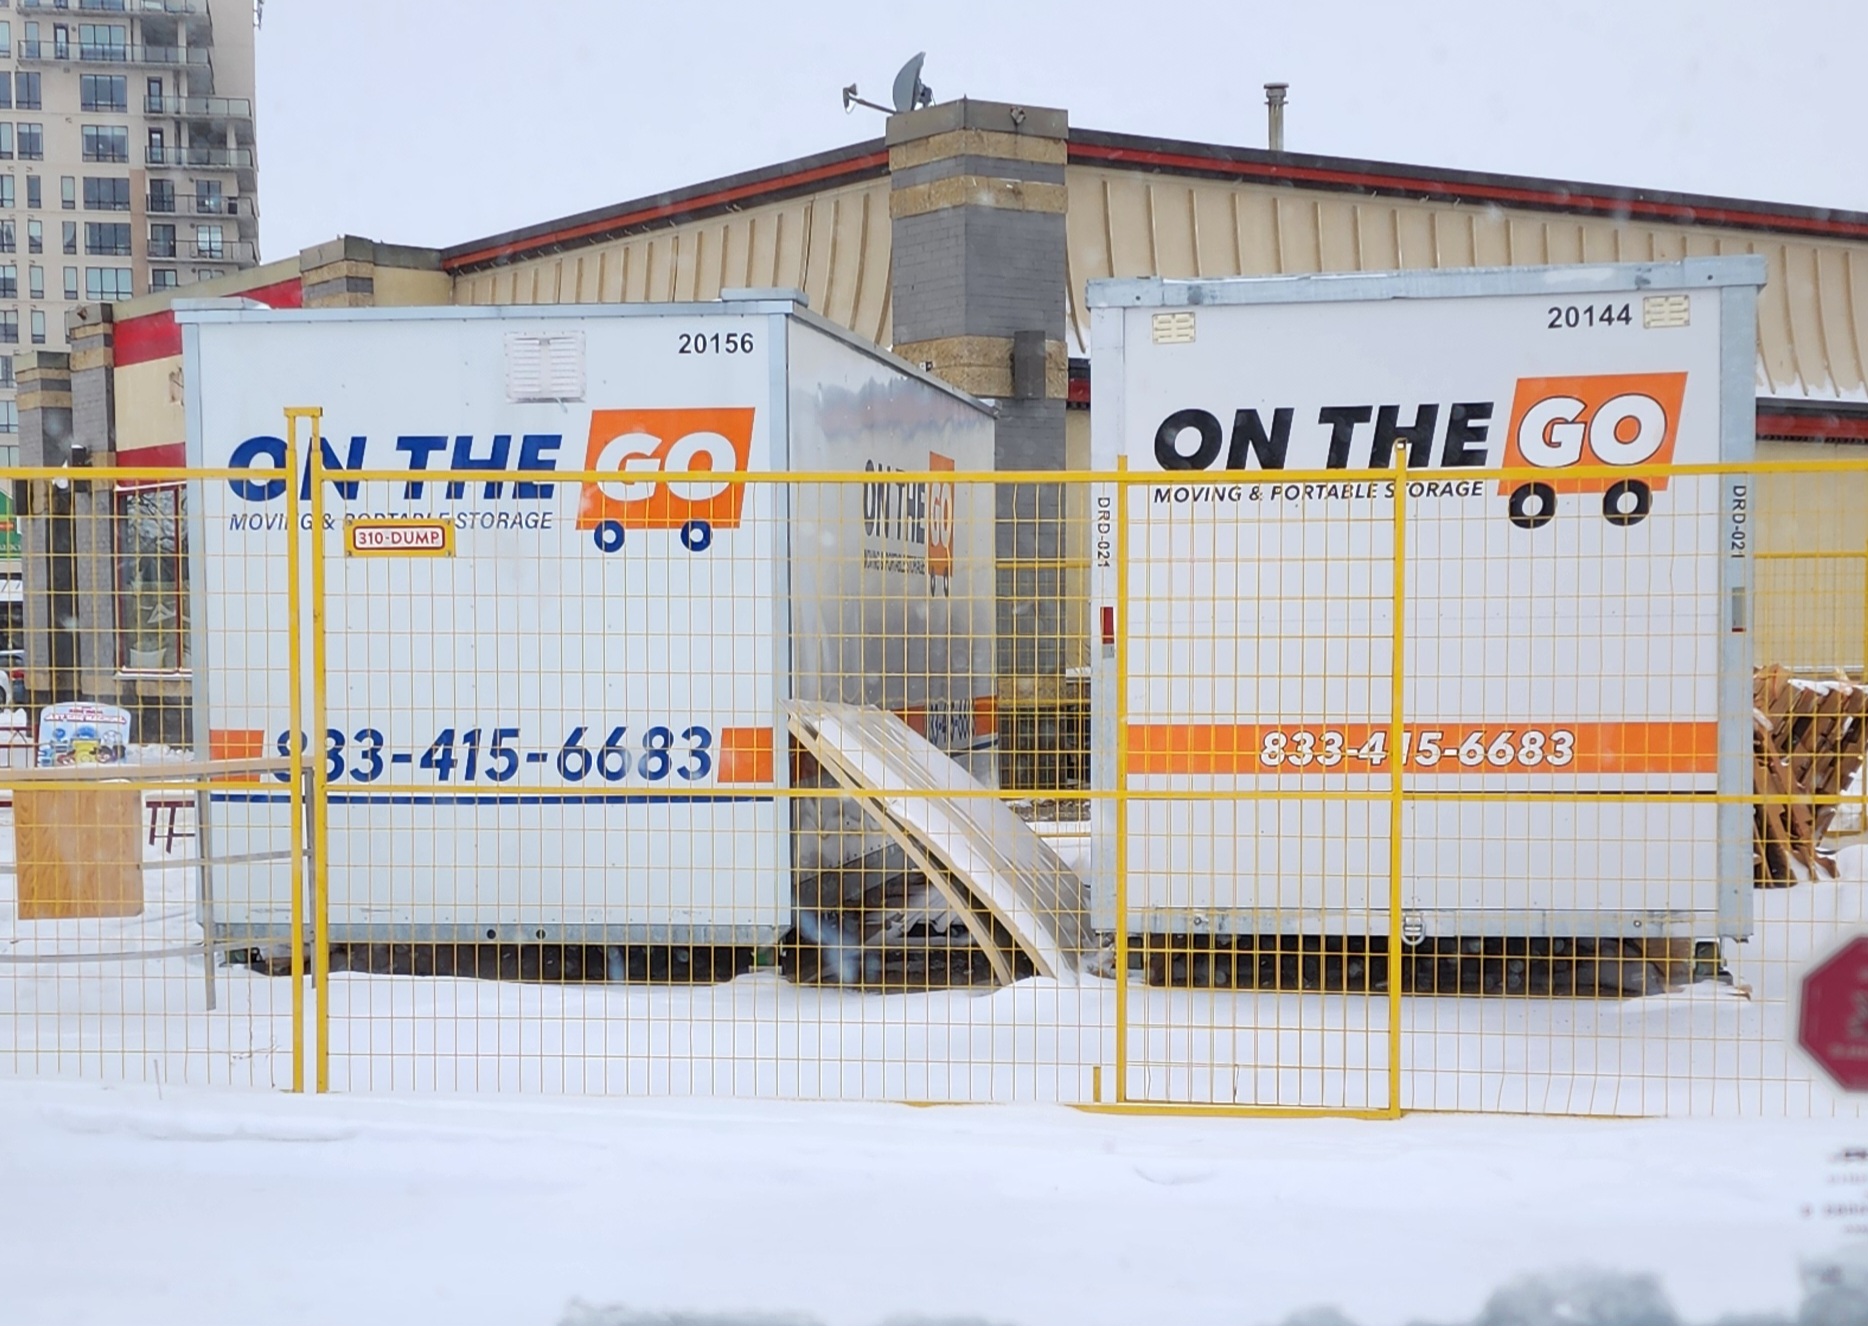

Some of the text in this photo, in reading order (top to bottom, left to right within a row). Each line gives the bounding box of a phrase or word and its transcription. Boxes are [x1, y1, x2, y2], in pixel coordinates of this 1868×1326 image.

[1547, 303, 1632, 330] 20144
[678, 333, 755, 355] 20156
[1154, 393, 1668, 472] ON THE GO
[228, 431, 737, 502] ON THE GO
[1154, 480, 1484, 503] MOVING & PORTABLE SORAGE
[322, 513, 335, 530] &
[455, 511, 553, 530] STORAGE
[1097, 497, 1111, 568] DRD-021
[1731, 485, 1747, 559] DRD-021
[358, 530, 440, 545] 310-DUMP
